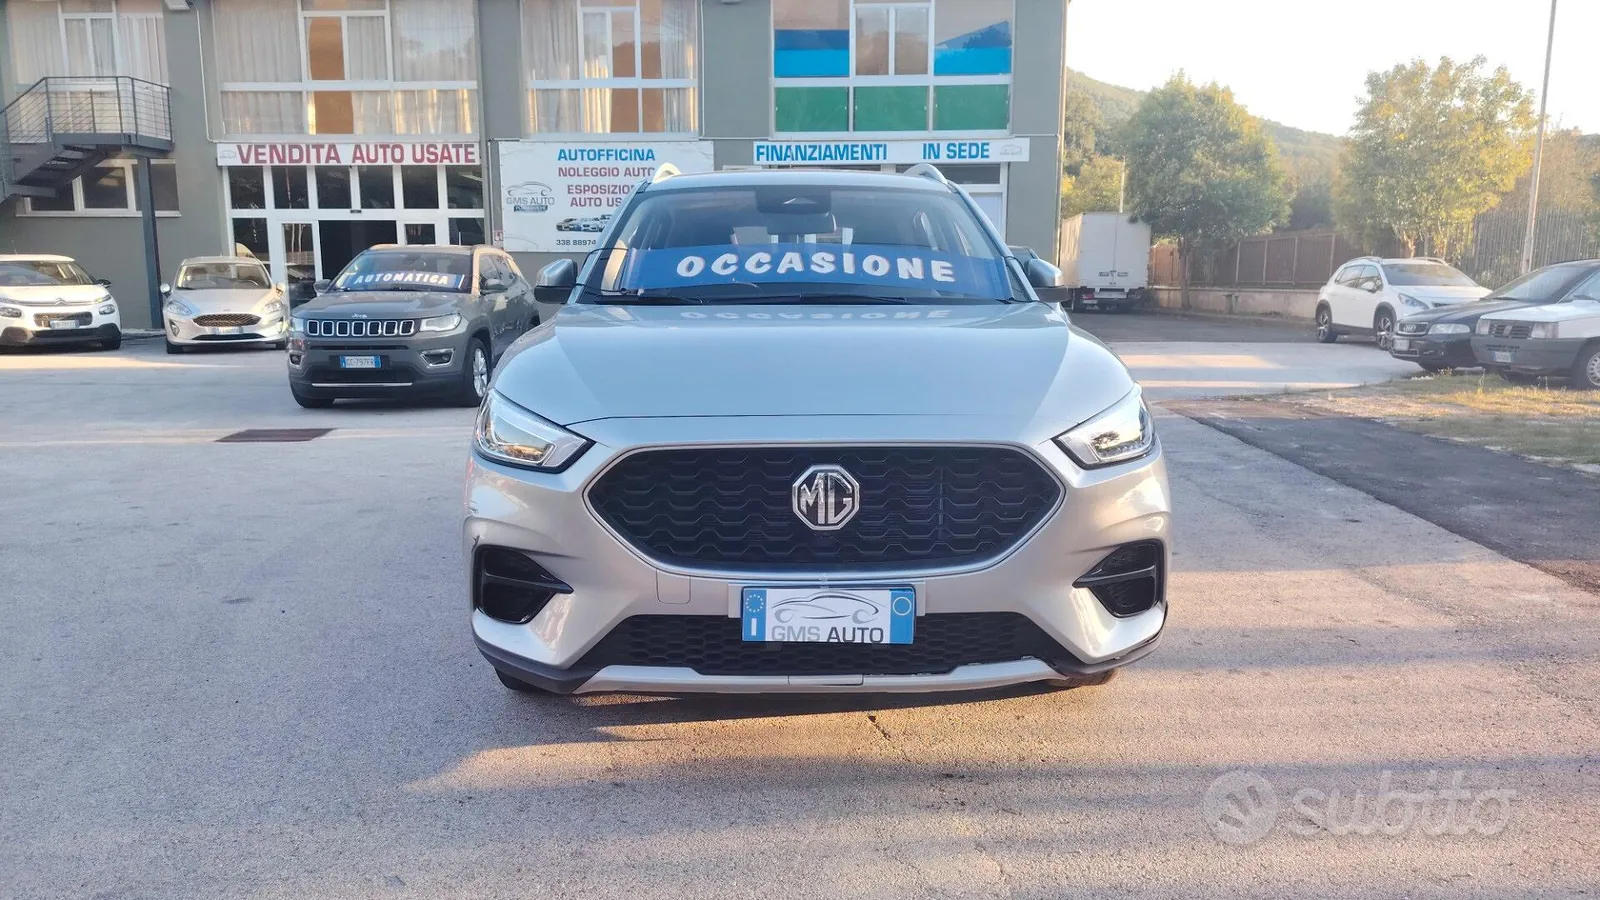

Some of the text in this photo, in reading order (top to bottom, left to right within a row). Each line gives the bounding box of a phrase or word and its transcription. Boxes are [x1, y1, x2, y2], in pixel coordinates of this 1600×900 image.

[237, 143, 475, 164] VENDITA AUTO USATE
[557, 149, 656, 161] AUTOFFICINA
[756, 142, 990, 161] FINANZIAMENTI IN SEDE
[558, 167, 620, 177] NOLEGGIO
[506, 197, 555, 205] GMS AUTO
[570, 197, 623, 207] AUTO US
[676, 251, 957, 283] OCCASIONE
[353, 272, 449, 285] AUTOMATICA
[801, 472, 853, 524] MG
[771, 625, 884, 643] GMS AUTO
